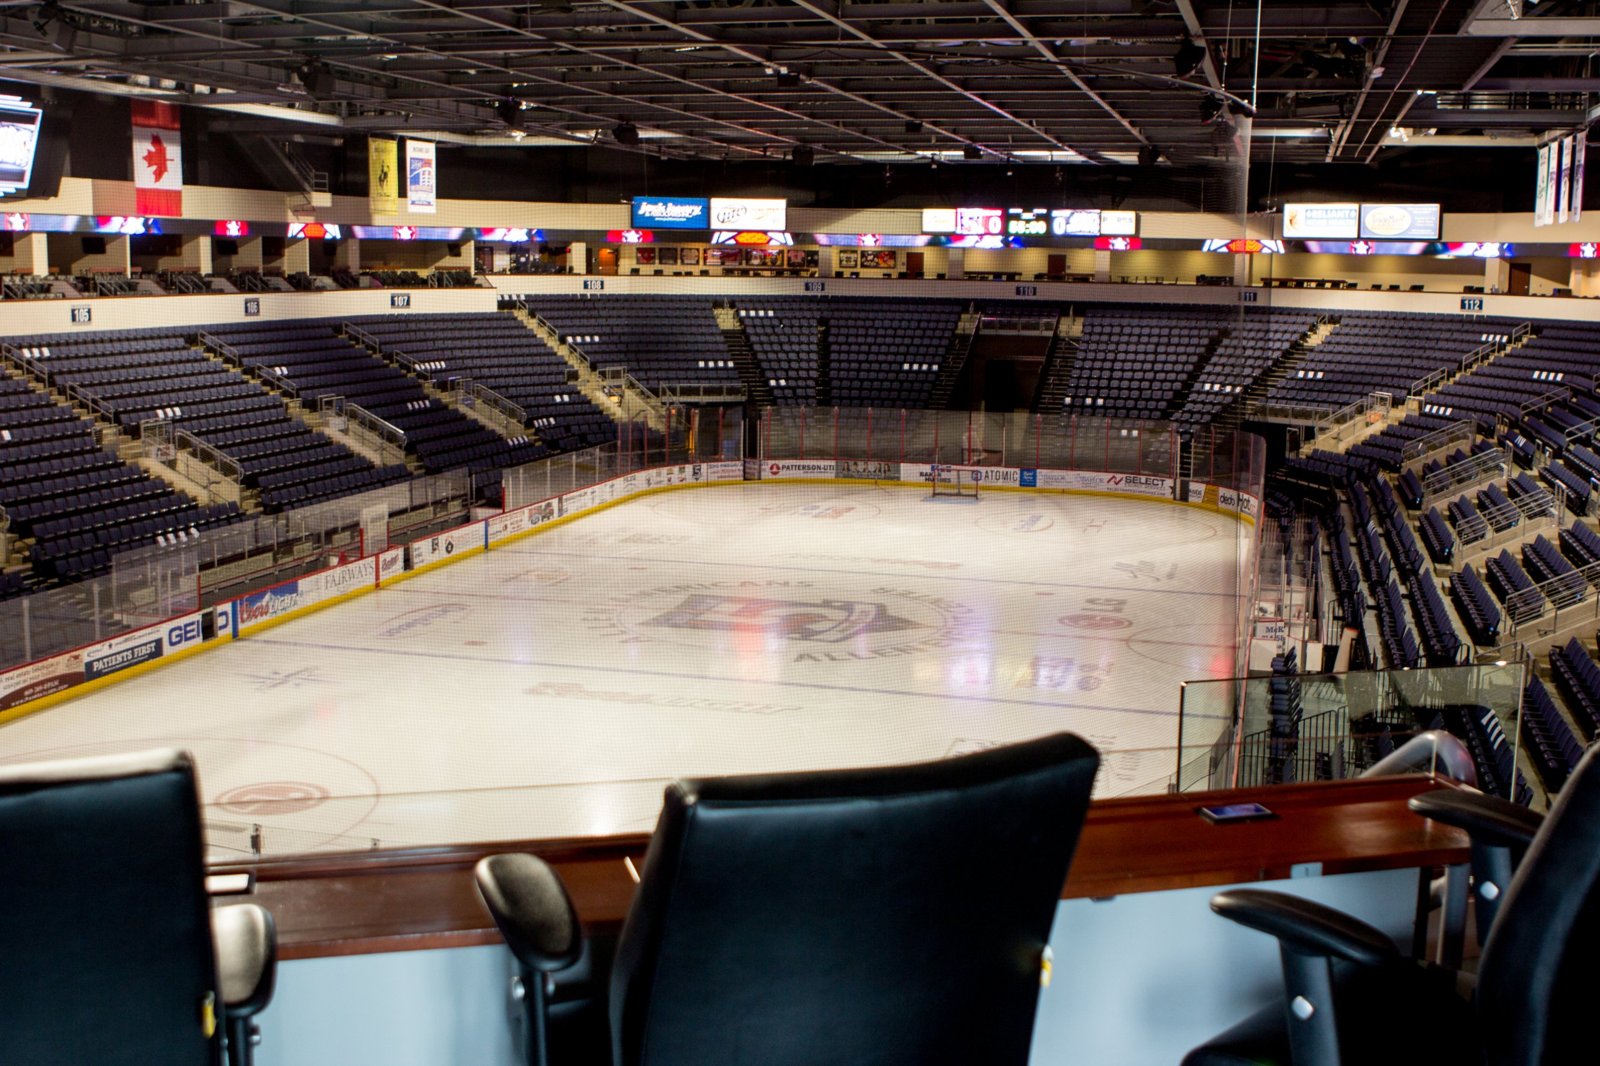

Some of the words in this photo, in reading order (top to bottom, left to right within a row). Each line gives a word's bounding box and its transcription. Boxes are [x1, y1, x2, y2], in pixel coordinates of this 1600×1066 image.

[586, 280, 601, 289] 108
[808, 282, 822, 291] 109
[393, 296, 408, 306] 107
[1464, 300, 1480, 310] 112
[74, 308, 89, 321] 105
[781, 464, 835, 472] PATTERSON-UTI
[984, 470, 1018, 482] ATOMIC
[1125, 475, 1166, 487] SELECT
[325, 560, 374, 590] FAIRWAYS
[239, 596, 270, 624] Coors
[268, 592, 299, 614] LIGHT
[168, 611, 229, 647] GEIO
[93, 650, 132, 672] PATIENTS
[134, 642, 156, 660] FIRST
